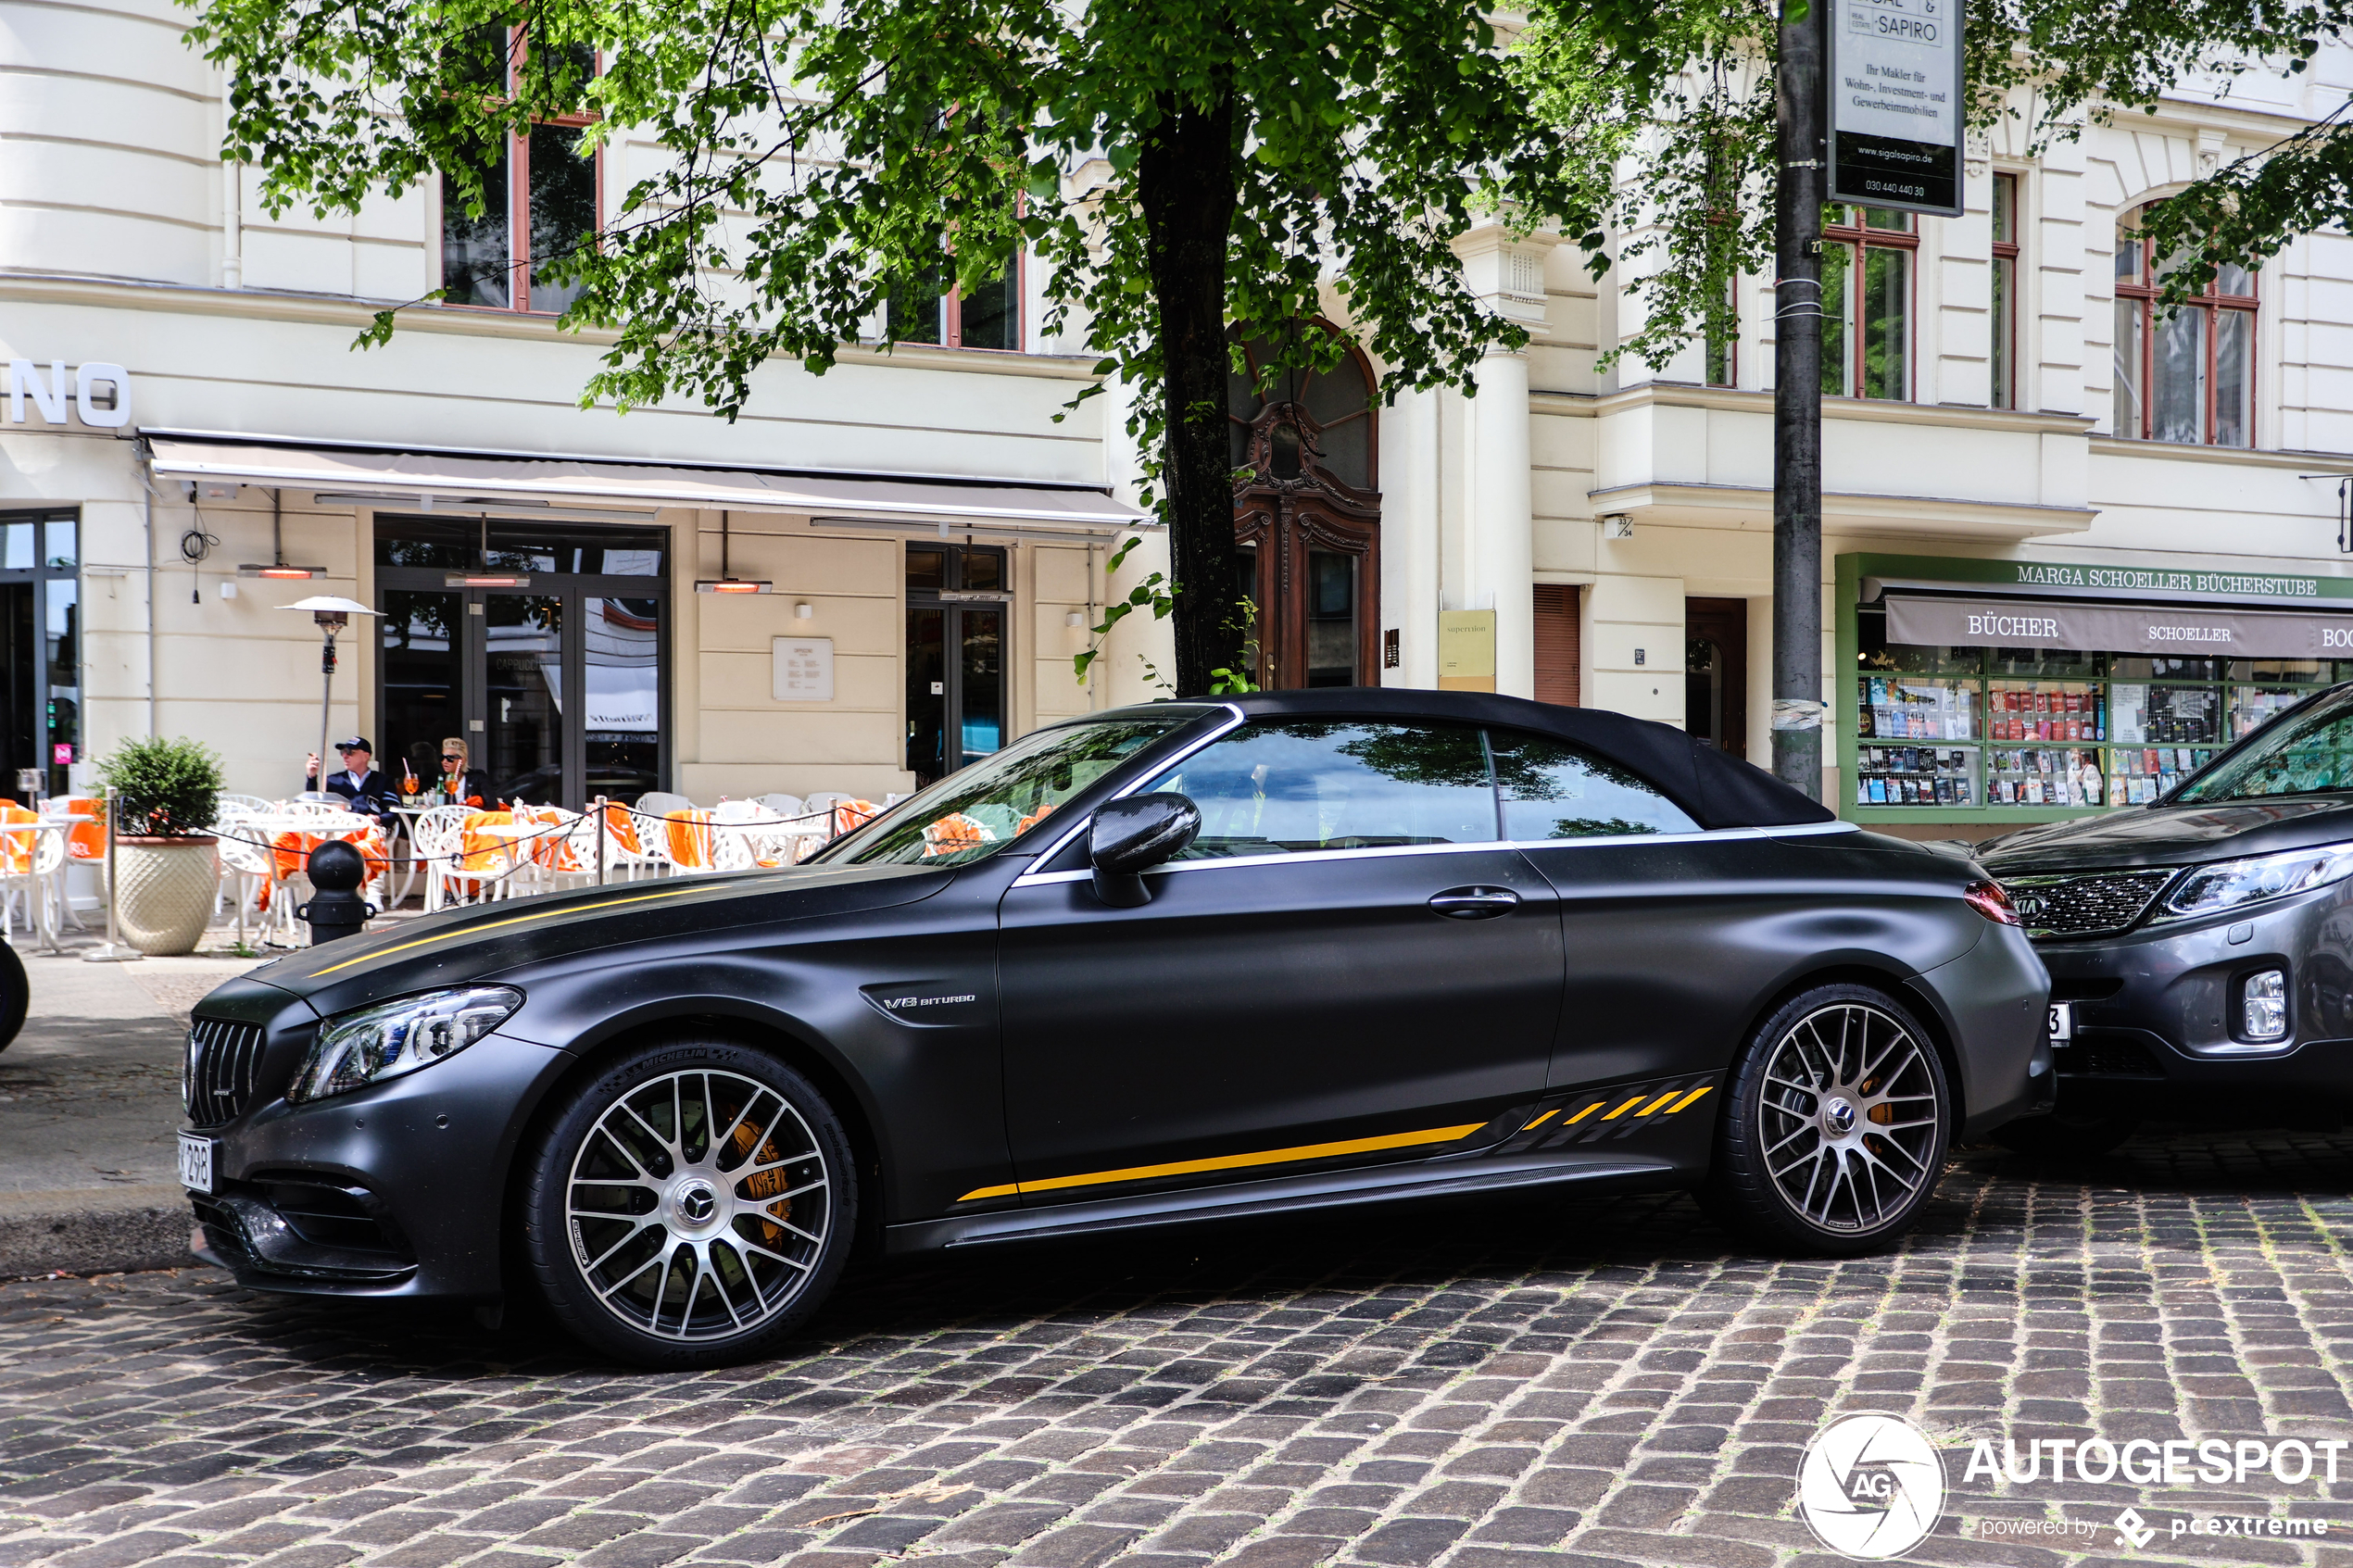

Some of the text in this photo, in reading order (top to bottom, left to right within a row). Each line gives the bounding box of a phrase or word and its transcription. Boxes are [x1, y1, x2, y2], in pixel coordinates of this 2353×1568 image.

[1879, 16, 1937, 41] SAPIRO
[1866, 64, 1926, 82] Ihr Makler für
[1879, 82, 1928, 99] Investment-
[1930, 92, 1945, 103] und
[1852, 95, 1938, 118] Gewerbeimmobilien
[1857, 147, 1933, 163] www.sigalsapiro.de
[1866, 180, 1925, 196] 030 440 440 30
[2018, 566, 2317, 596] MARGA SCHOELLER BÜCHERSTUBE
[1968, 611, 2058, 637] BÜCHER
[2148, 625, 2231, 643] SCHOELLER
[2014, 899, 2037, 914] KIA
[884, 995, 975, 1010] V8 BITURBO
[641, 1048, 707, 1069] MICHELIN
[187, 1143, 208, 1185] 298
